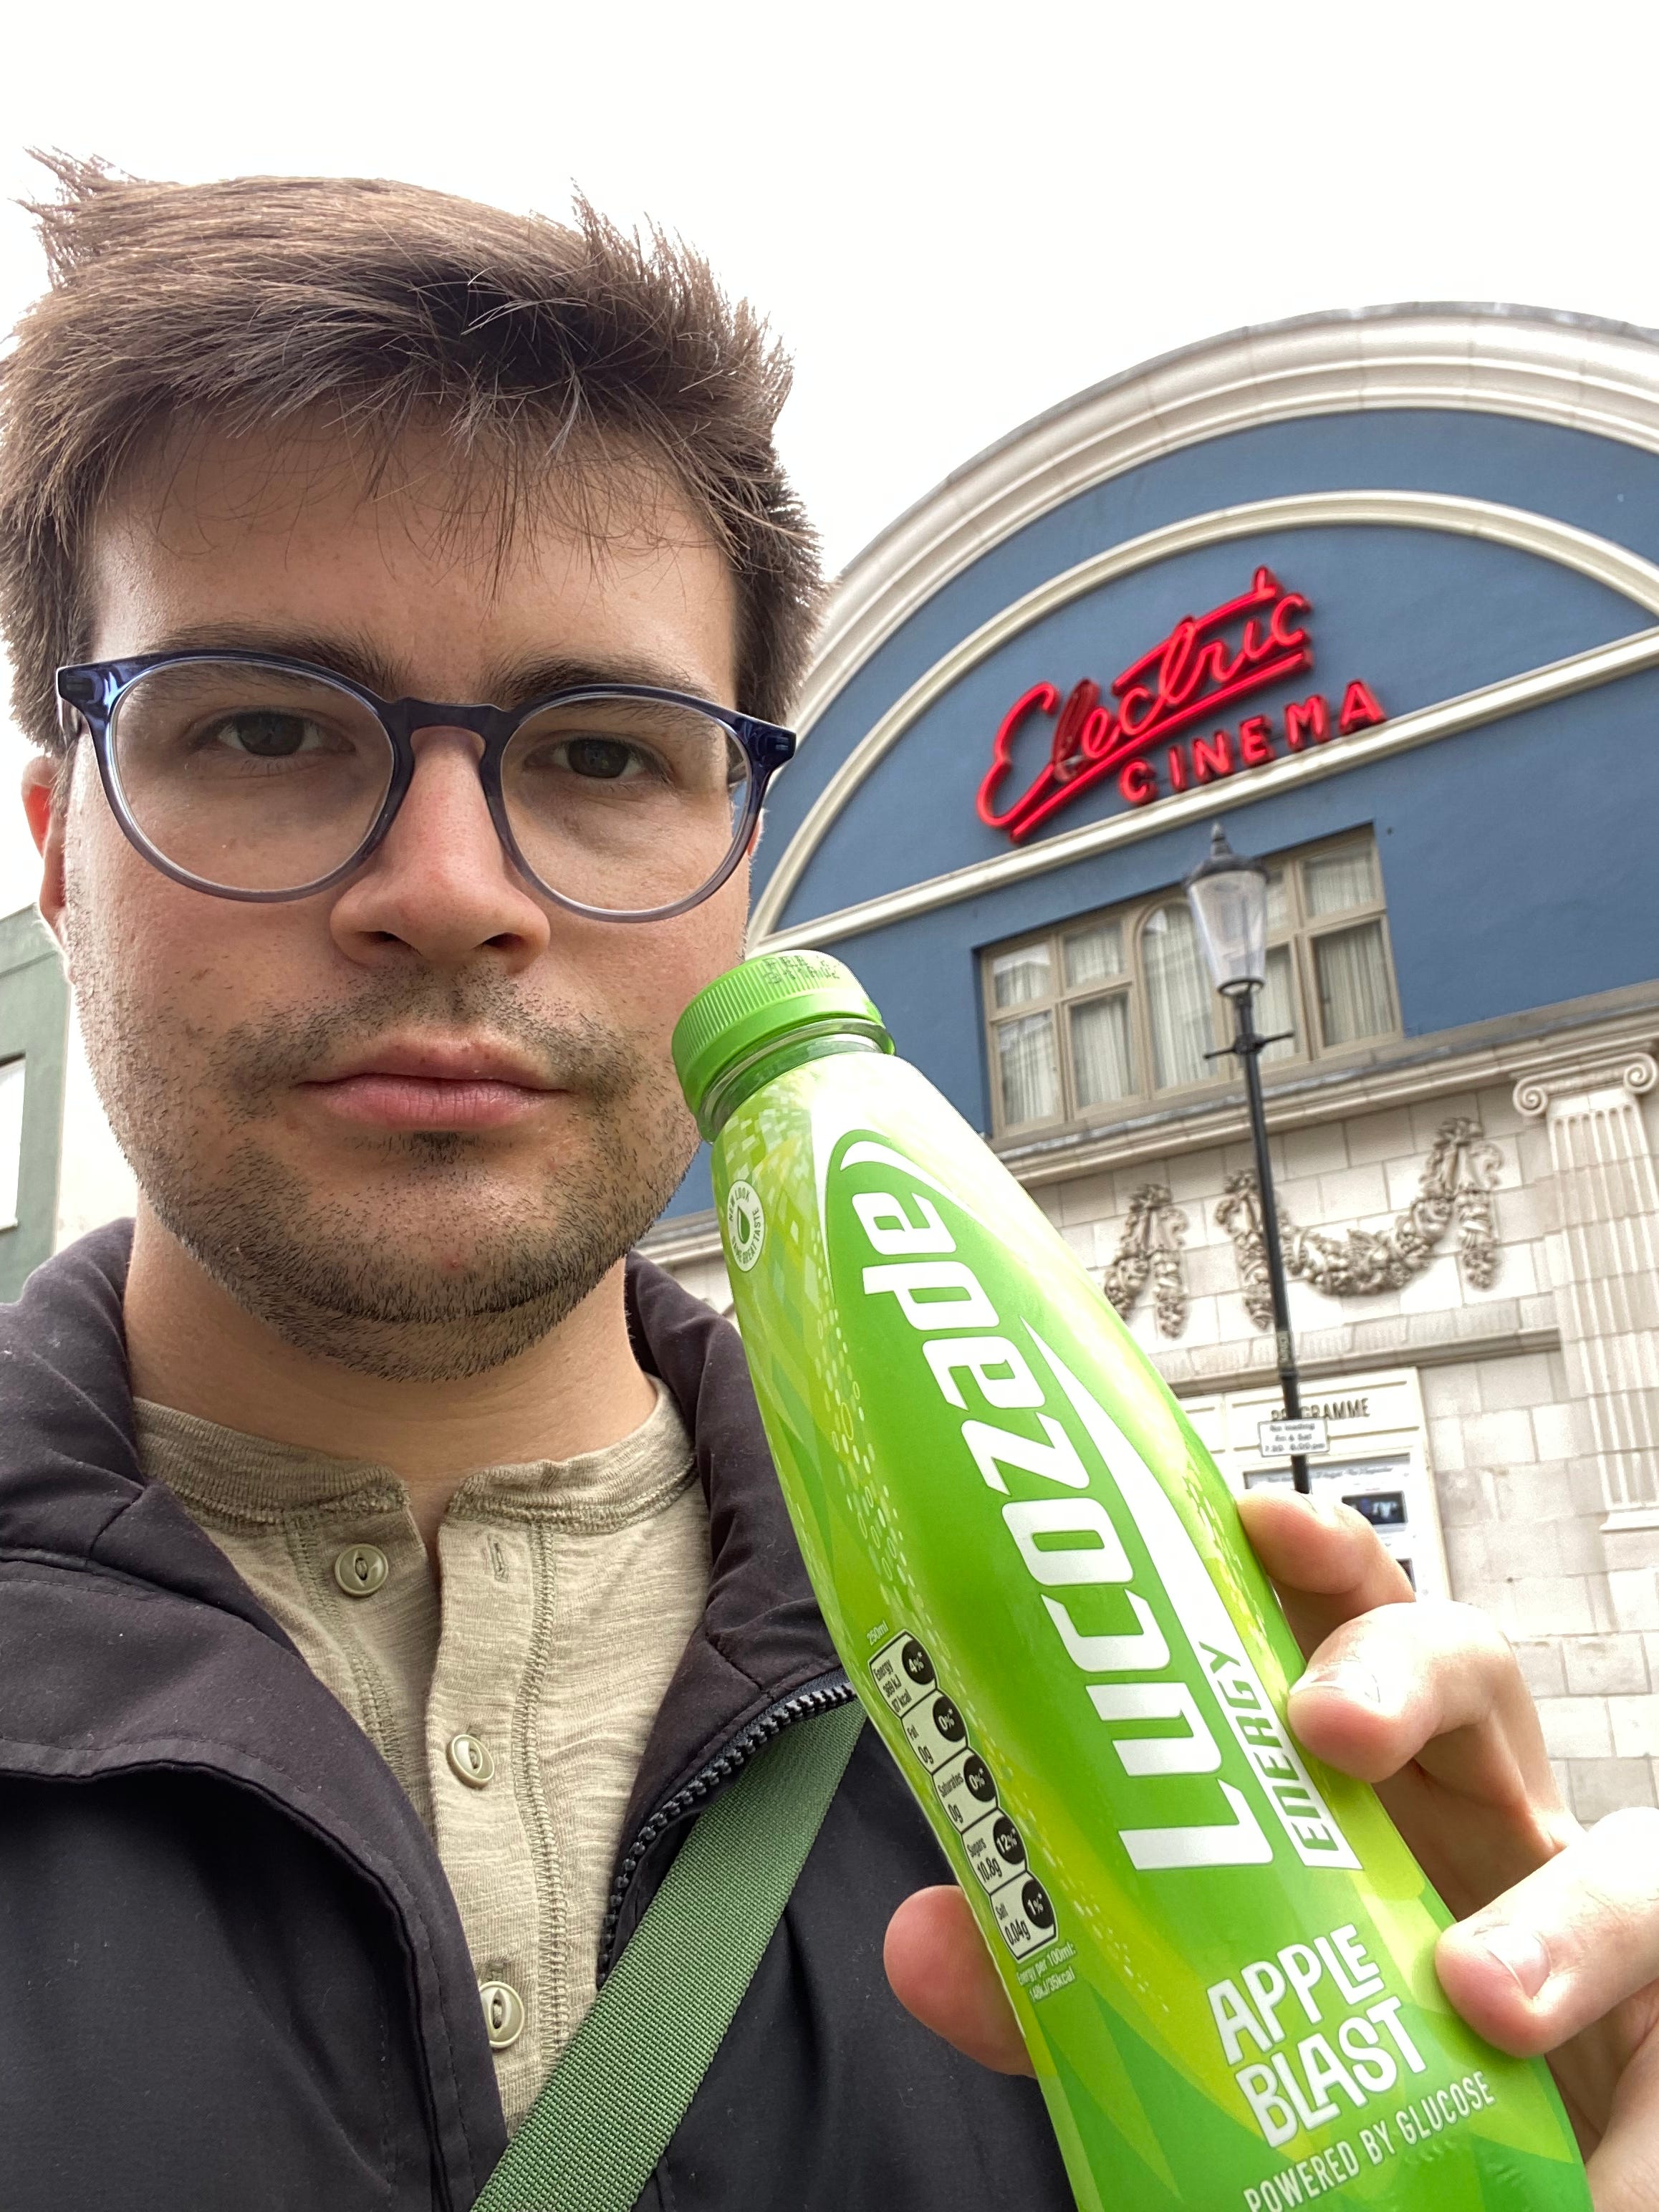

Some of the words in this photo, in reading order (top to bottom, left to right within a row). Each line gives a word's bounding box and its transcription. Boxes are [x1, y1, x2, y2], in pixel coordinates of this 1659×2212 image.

[976, 564, 1312, 831] Electric
[1119, 679, 1388, 806] CINEMA
[752, 1206, 761, 1242] TASTE
[1271, 1398, 1370, 1421] PGRAMME
[852, 1191, 1274, 1870] Lucozade
[872, 1659, 894, 1681] Energy
[906, 1724, 919, 1741] Fat
[1198, 1640, 1339, 1852] ENERGY
[918, 1746, 934, 1764] 0g
[937, 1771, 964, 1798] Saturates
[948, 1803, 963, 1824] 0g
[967, 1837, 987, 1857] Sugars
[976, 1857, 1003, 1883] 10.8g
[995, 1903, 1009, 1920] Salt
[1004, 1919, 1032, 1946] 0.04g
[1035, 1959, 1047, 1978] per
[1206, 1923, 1385, 2065] APPLE
[1236, 1996, 1427, 2148] BLAST
[1244, 2140, 1360, 2212] POWERED
[1359, 2120, 1395, 2165] BY
[1395, 2071, 1496, 2145] GLUCOSE
